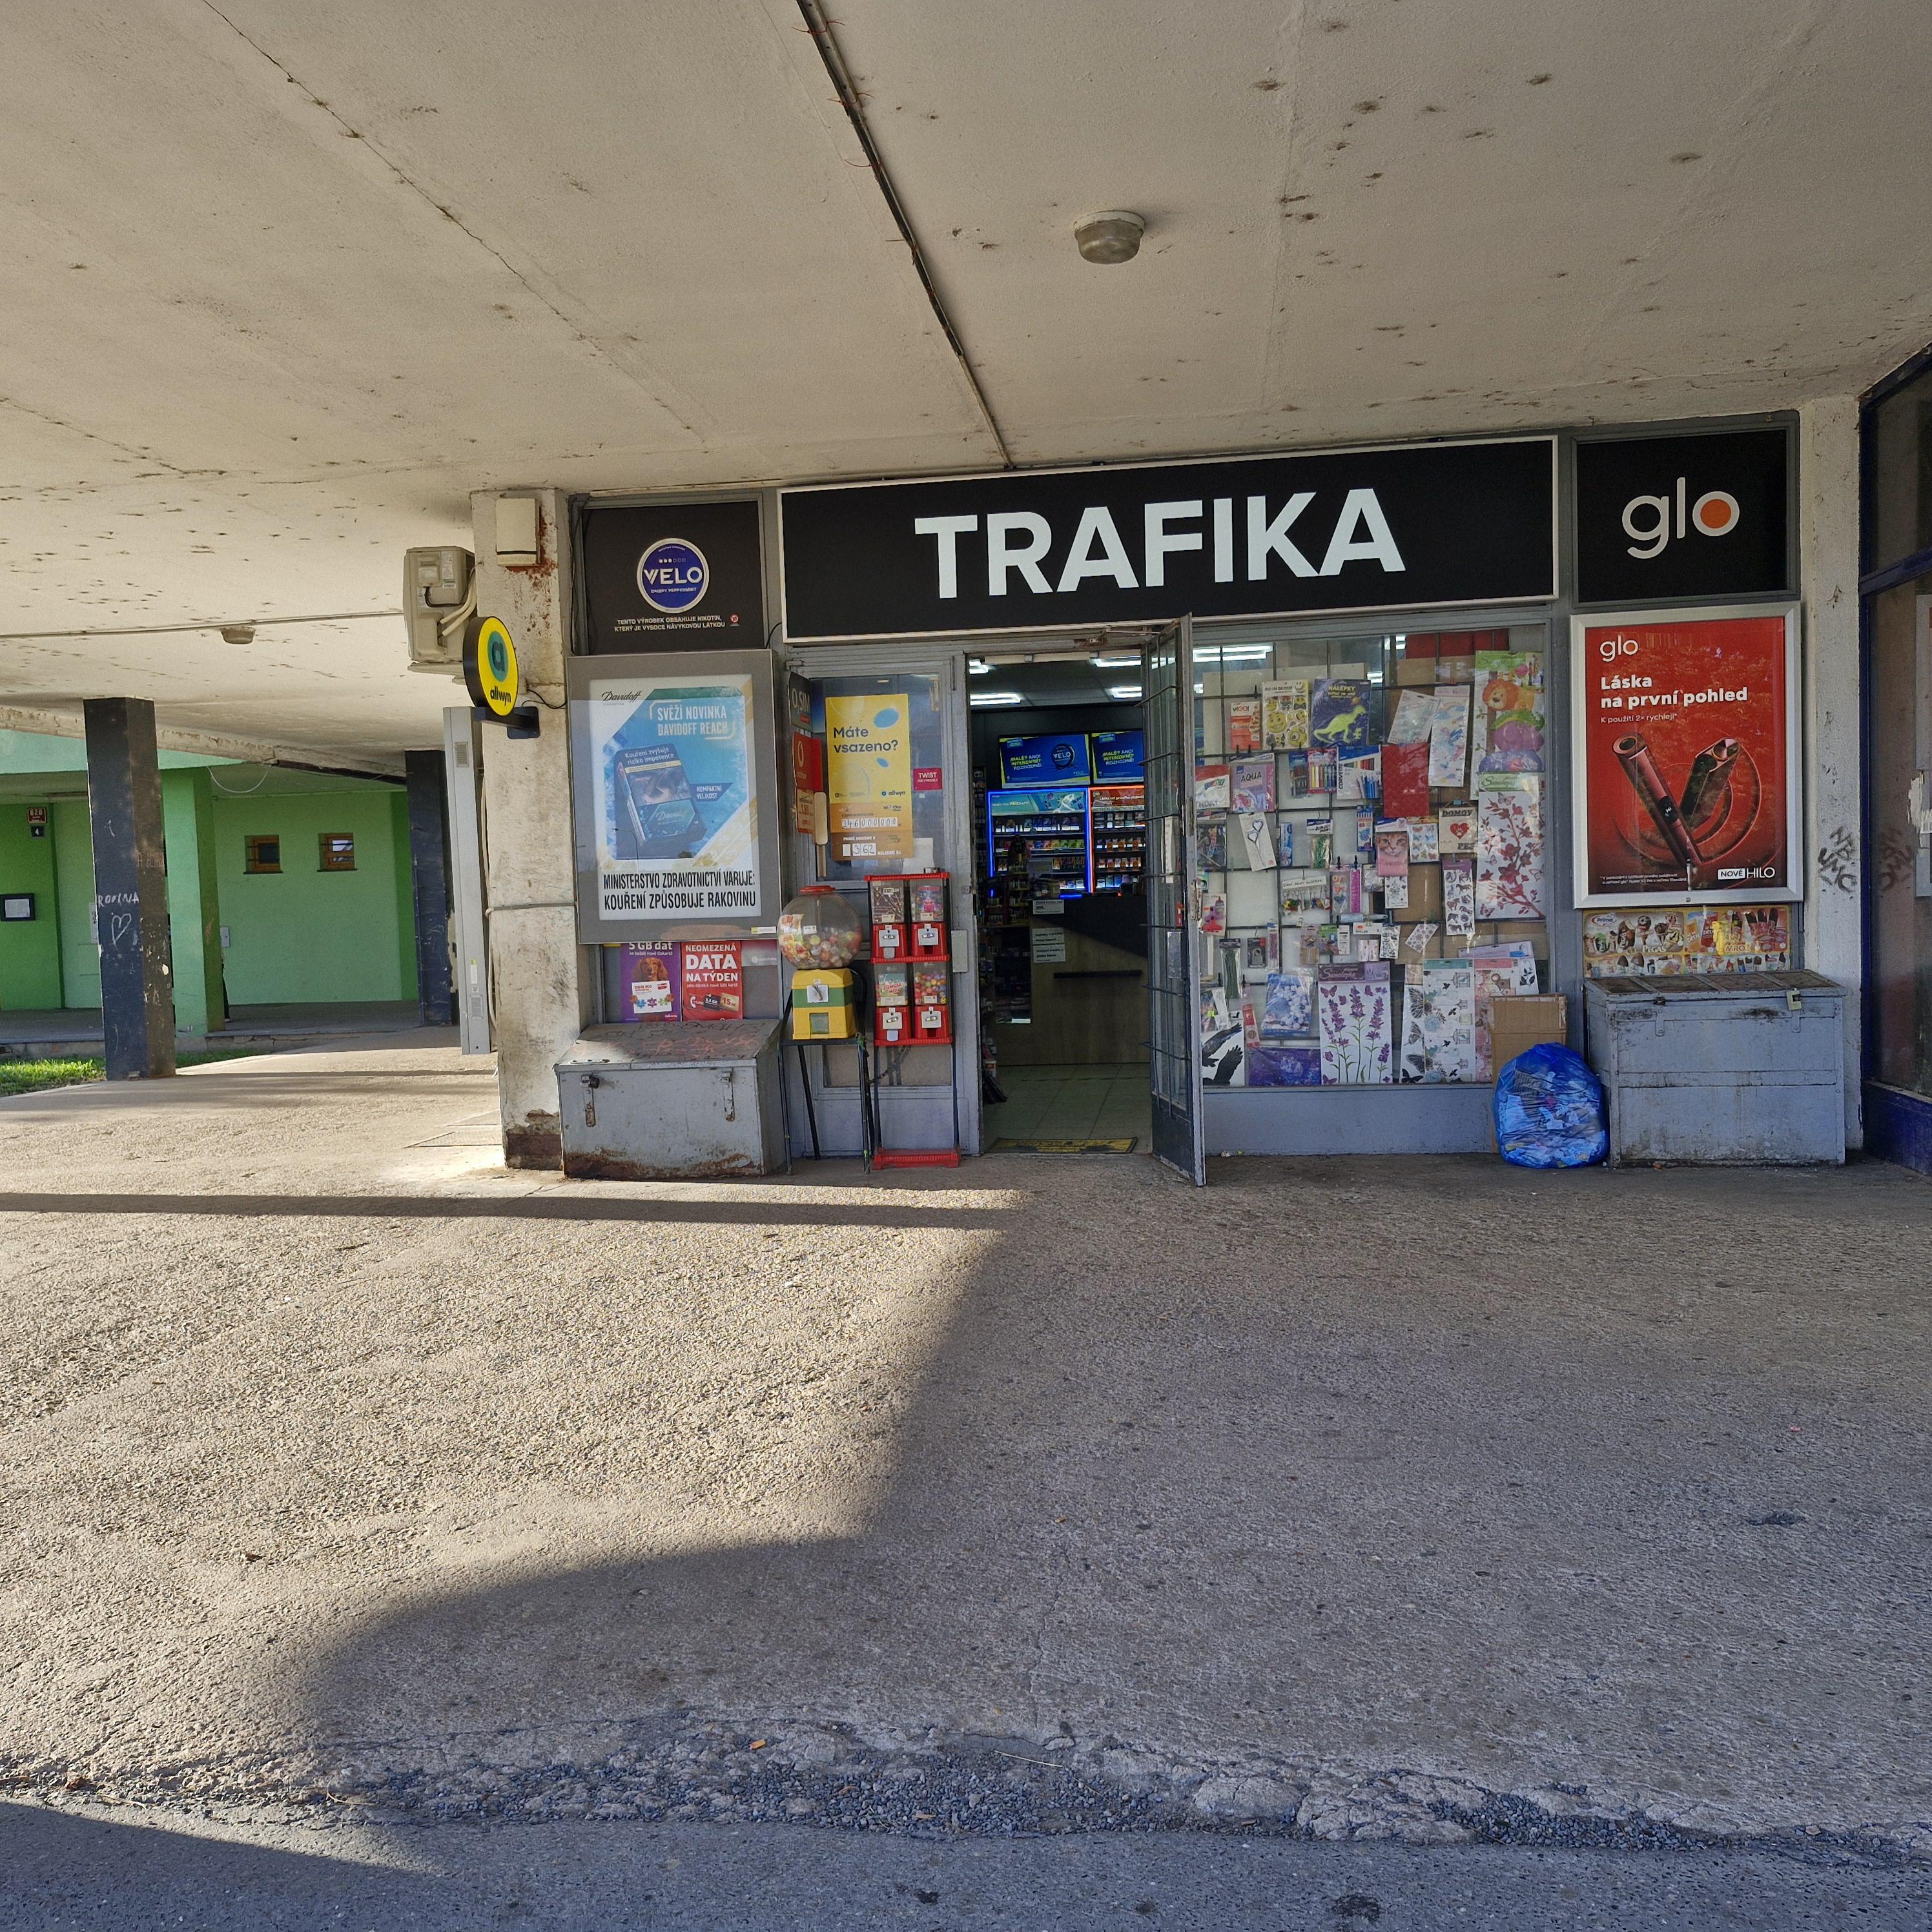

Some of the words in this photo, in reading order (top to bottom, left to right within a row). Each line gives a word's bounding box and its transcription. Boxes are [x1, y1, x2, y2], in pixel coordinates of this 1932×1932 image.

[1621, 477, 1740, 559] glo
[914, 488, 1406, 599] TRAFIKA
[643, 567, 703, 585] VELO
[1599, 635, 1638, 662] glo
[1601, 674, 1652, 690] Láska
[490, 685, 511, 706] allwyn
[601, 690, 642, 703] Davidoff
[1601, 697, 1622, 708] na
[1628, 690, 1679, 710] první
[1683, 687, 1748, 707] pohled
[657, 704, 683, 721] SVĚŽÍ
[686, 705, 726, 719] NOVINKA
[1608, 714, 1634, 724] použití
[658, 723, 697, 736] DAVIDOFF
[700, 721, 728, 735] REACH
[834, 726, 868, 738] Máte
[834, 739, 898, 753] vsazeno?
[625, 749, 647, 759] Kouření
[645, 753, 674, 763] impotence
[1240, 772, 1262, 783] AQUA
[852, 844, 875, 854] 362
[1721, 868, 1743, 877] NOVÉ
[1747, 867, 1775, 878] HILO
[604, 872, 660, 890] MINISTERSTVO
[663, 870, 721, 889] ZDRAVOTNICTVÍ
[723, 870, 755, 887] VARUJE:
[604, 891, 646, 910] KOUŘENÍ
[649, 889, 704, 909] ZPŮSOBUJE
[708, 891, 755, 907] RAKOVINU
[654, 942, 673, 951] dat
[686, 943, 736, 952] NEOMEZENÁ
[686, 954, 737, 970] DATA
[686, 974, 701, 982] NA
[703, 971, 738, 982] TÝDEN
[723, 997, 730, 1005] 15
